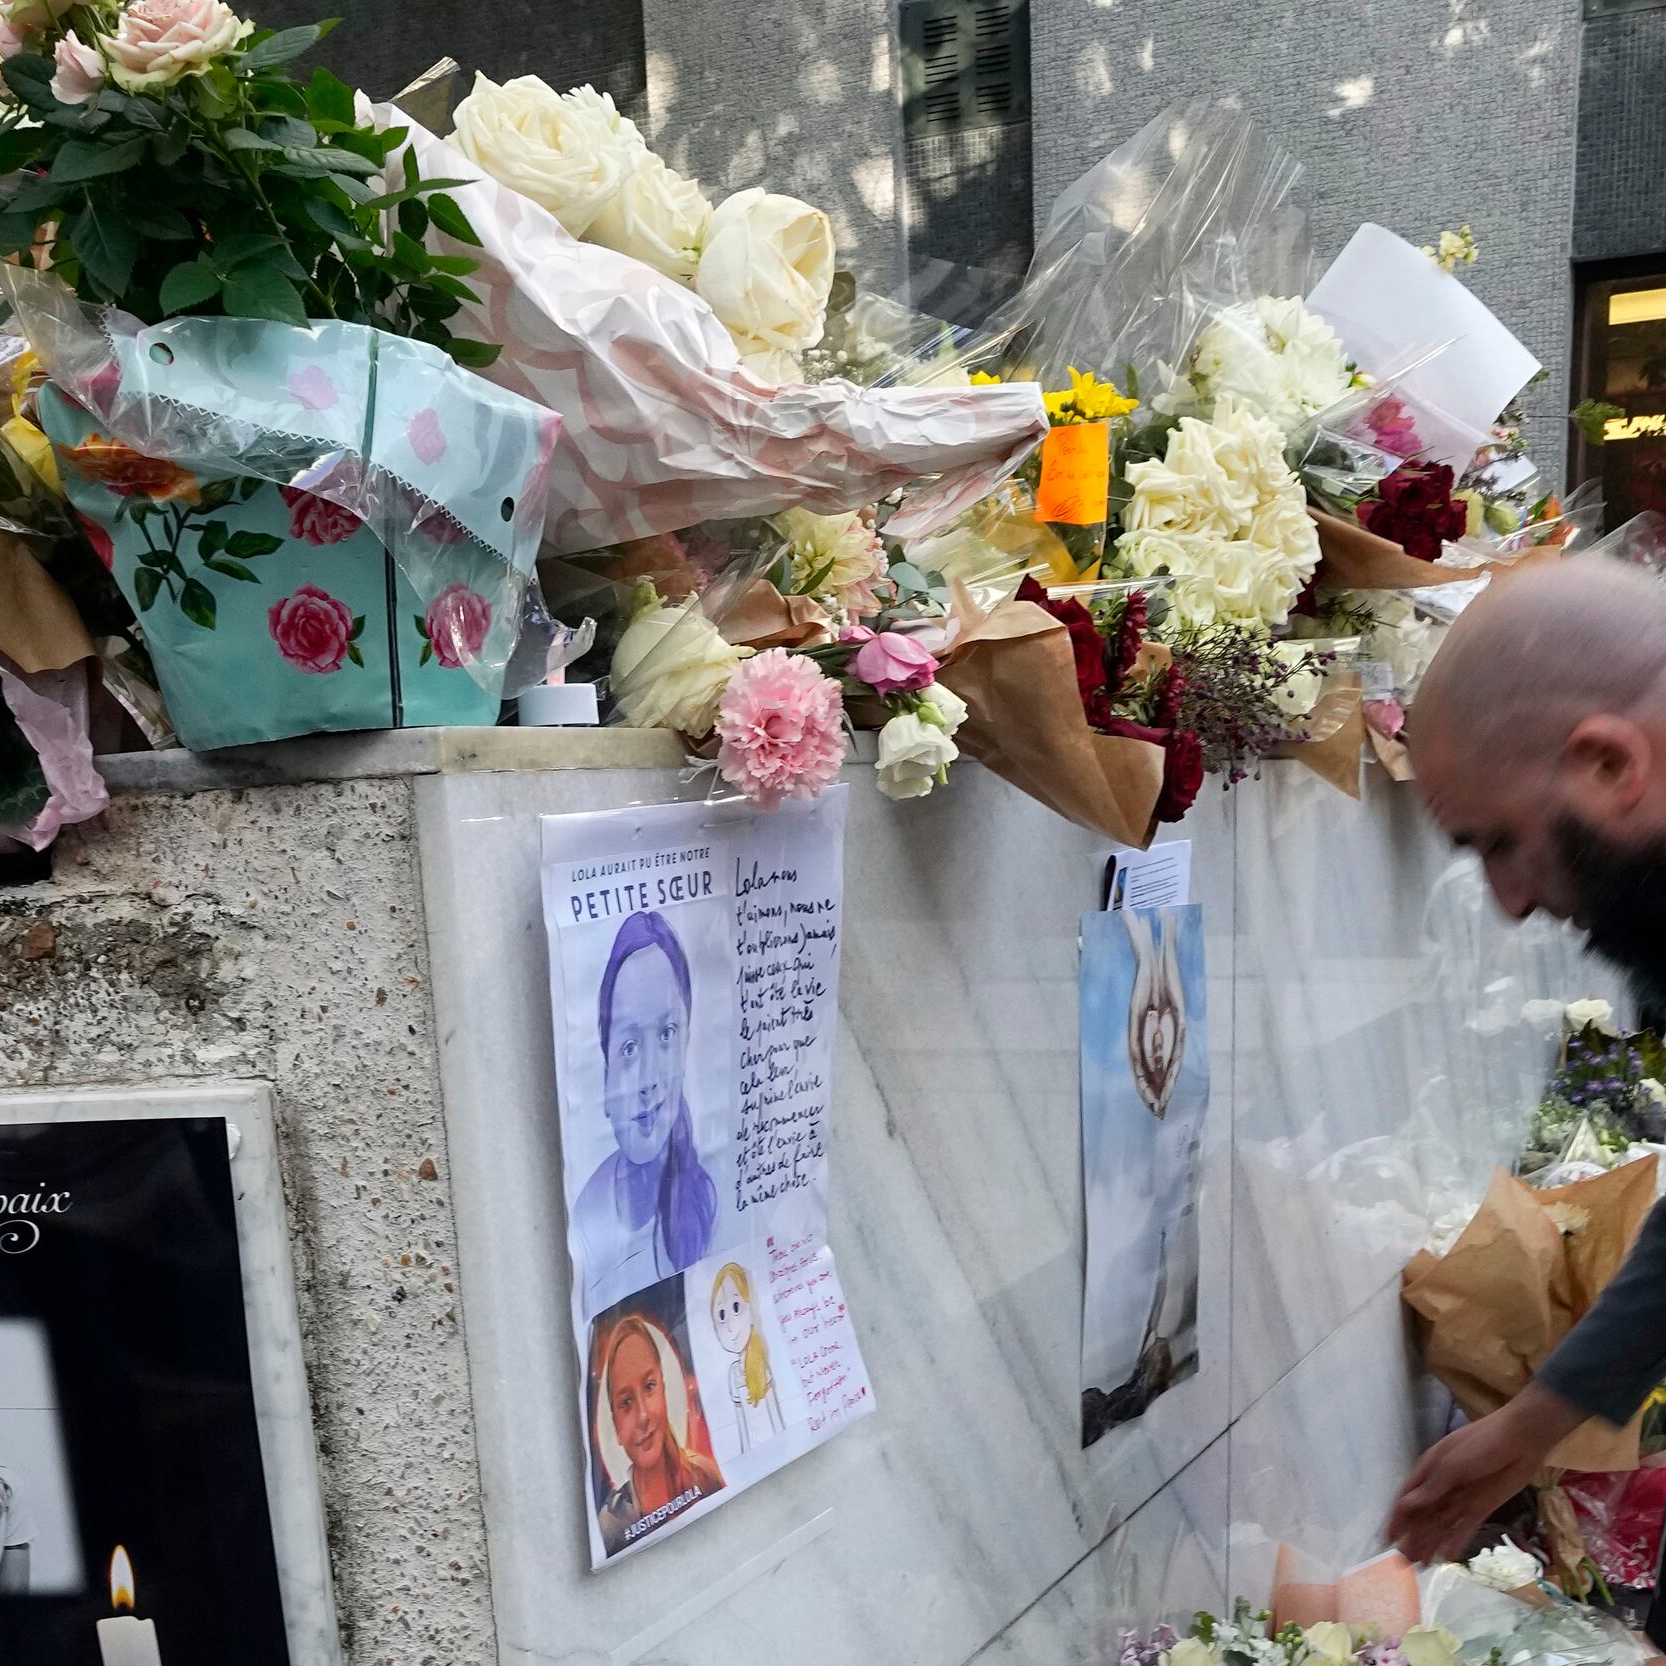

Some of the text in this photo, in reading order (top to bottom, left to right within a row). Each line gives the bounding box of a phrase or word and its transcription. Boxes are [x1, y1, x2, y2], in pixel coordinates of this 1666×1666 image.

[572, 867, 596, 882] LOLA
[600, 860, 636, 877] AURAIT
[639, 857, 652, 870] PU
[679, 847, 710, 862] NOTRE
[571, 870, 713, 922] PETITE SŒUR
[805, 977, 828, 997] vie
